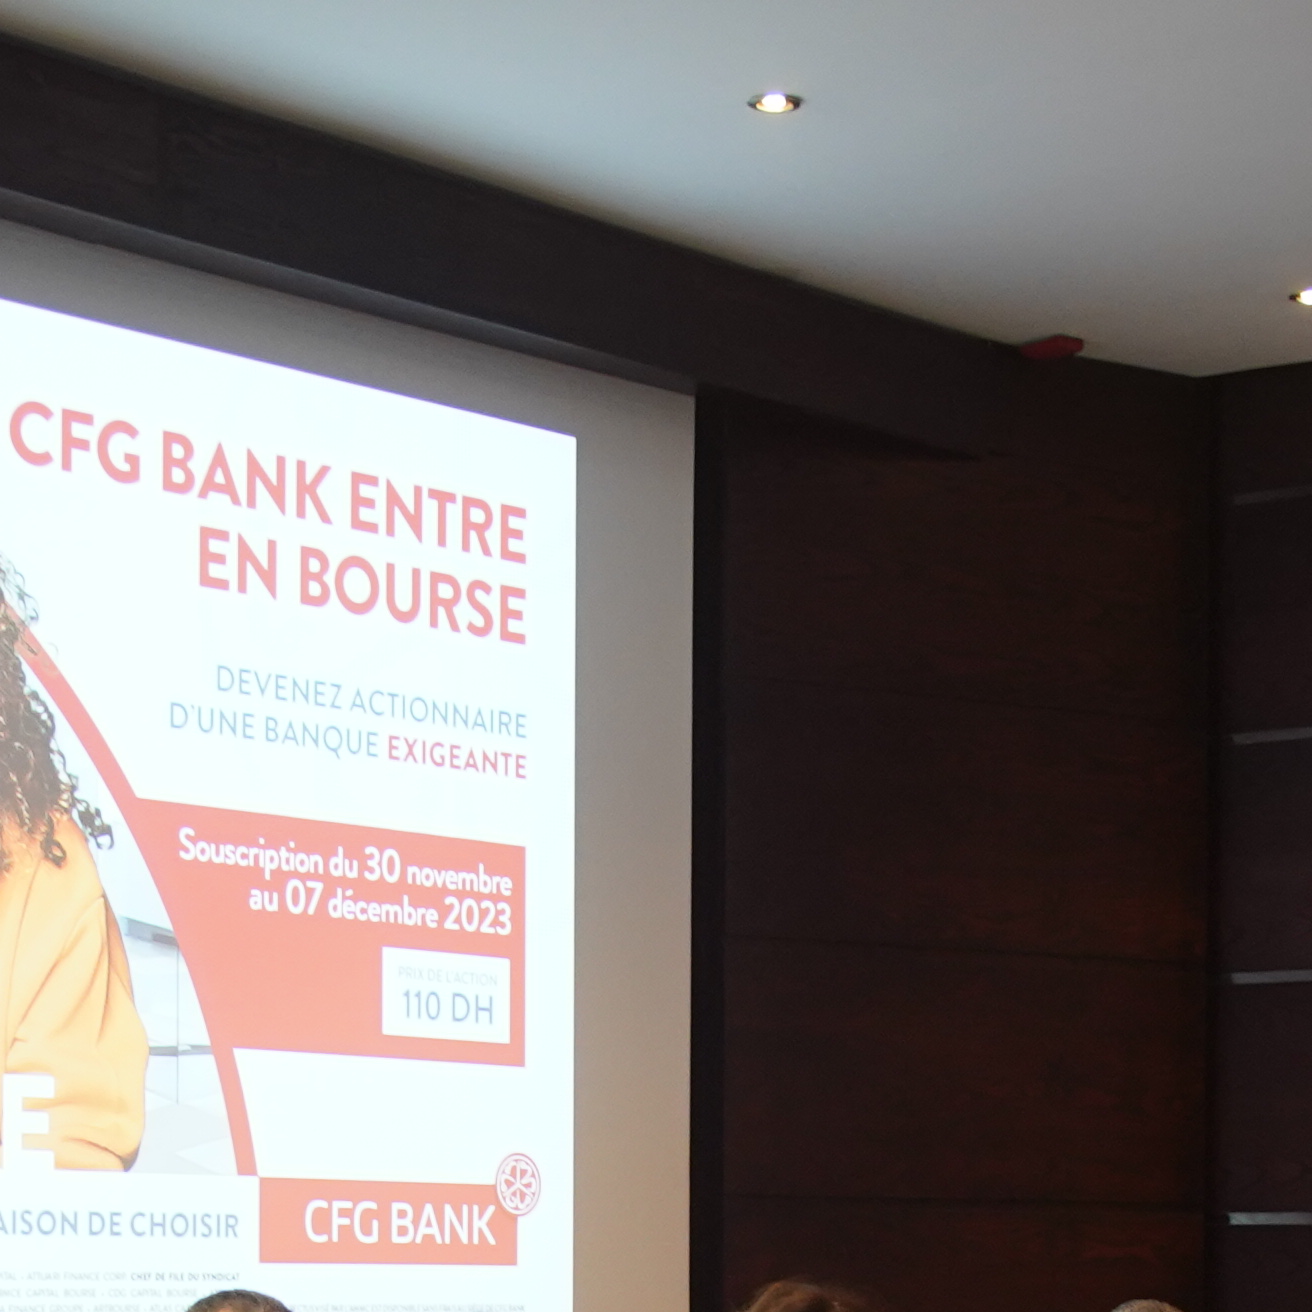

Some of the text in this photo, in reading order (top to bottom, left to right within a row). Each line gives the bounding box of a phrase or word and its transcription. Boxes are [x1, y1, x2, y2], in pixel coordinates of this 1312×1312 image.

[9, 401, 527, 564] CFG BANK ENTRE
[199, 525, 526, 645] EN BOURSE
[216, 665, 527, 739] DEVENEZ ACTIONNAIRE
[169, 702, 527, 779] D'UNE BANQUE EXIGEANTE
[179, 827, 513, 897] Souscription du 30 novembre
[249, 879, 512, 935] au 07 décembre 2023
[398, 966, 425, 980] PRIX
[427, 968, 443, 982] DE
[403, 989, 494, 1025] 110 DH
[89, 1211, 122, 1237] DE
[130, 1212, 239, 1238] CHOISIR
[304, 1199, 496, 1246] CFG BANK
